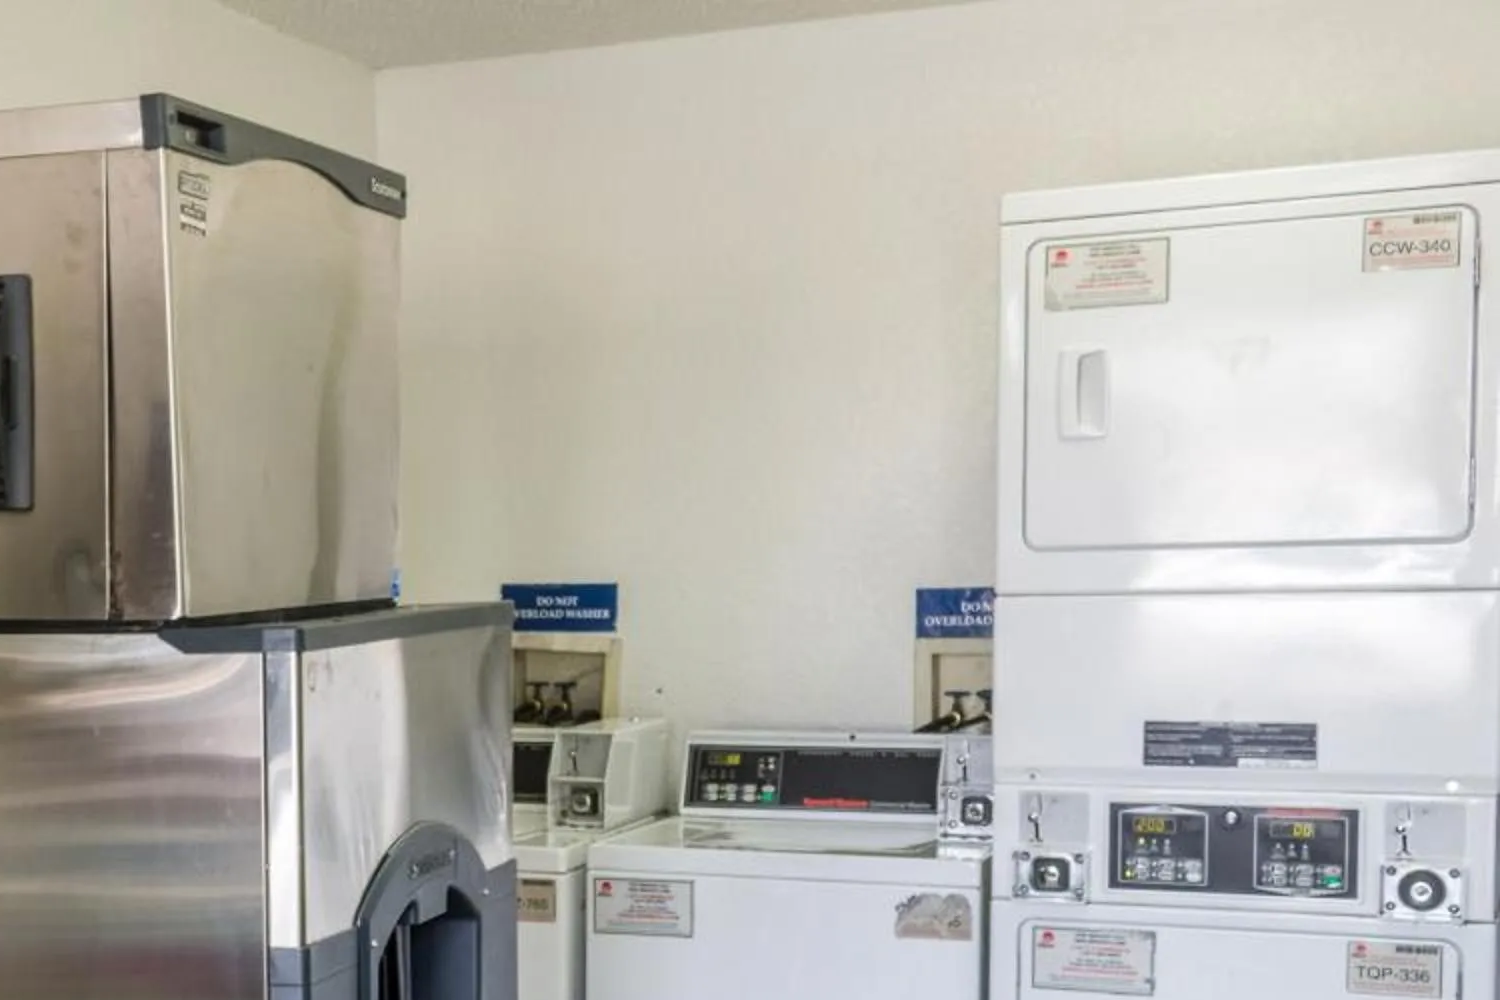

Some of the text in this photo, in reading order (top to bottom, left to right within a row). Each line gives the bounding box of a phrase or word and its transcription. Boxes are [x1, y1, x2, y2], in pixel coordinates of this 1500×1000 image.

[1369, 239, 1452, 257] CCW-340
[536, 596, 579, 606] DO NOT
[961, 601, 980, 612] DO
[514, 608, 610, 620] VERLOAD WASHER
[924, 614, 993, 627] OVERLOAD
